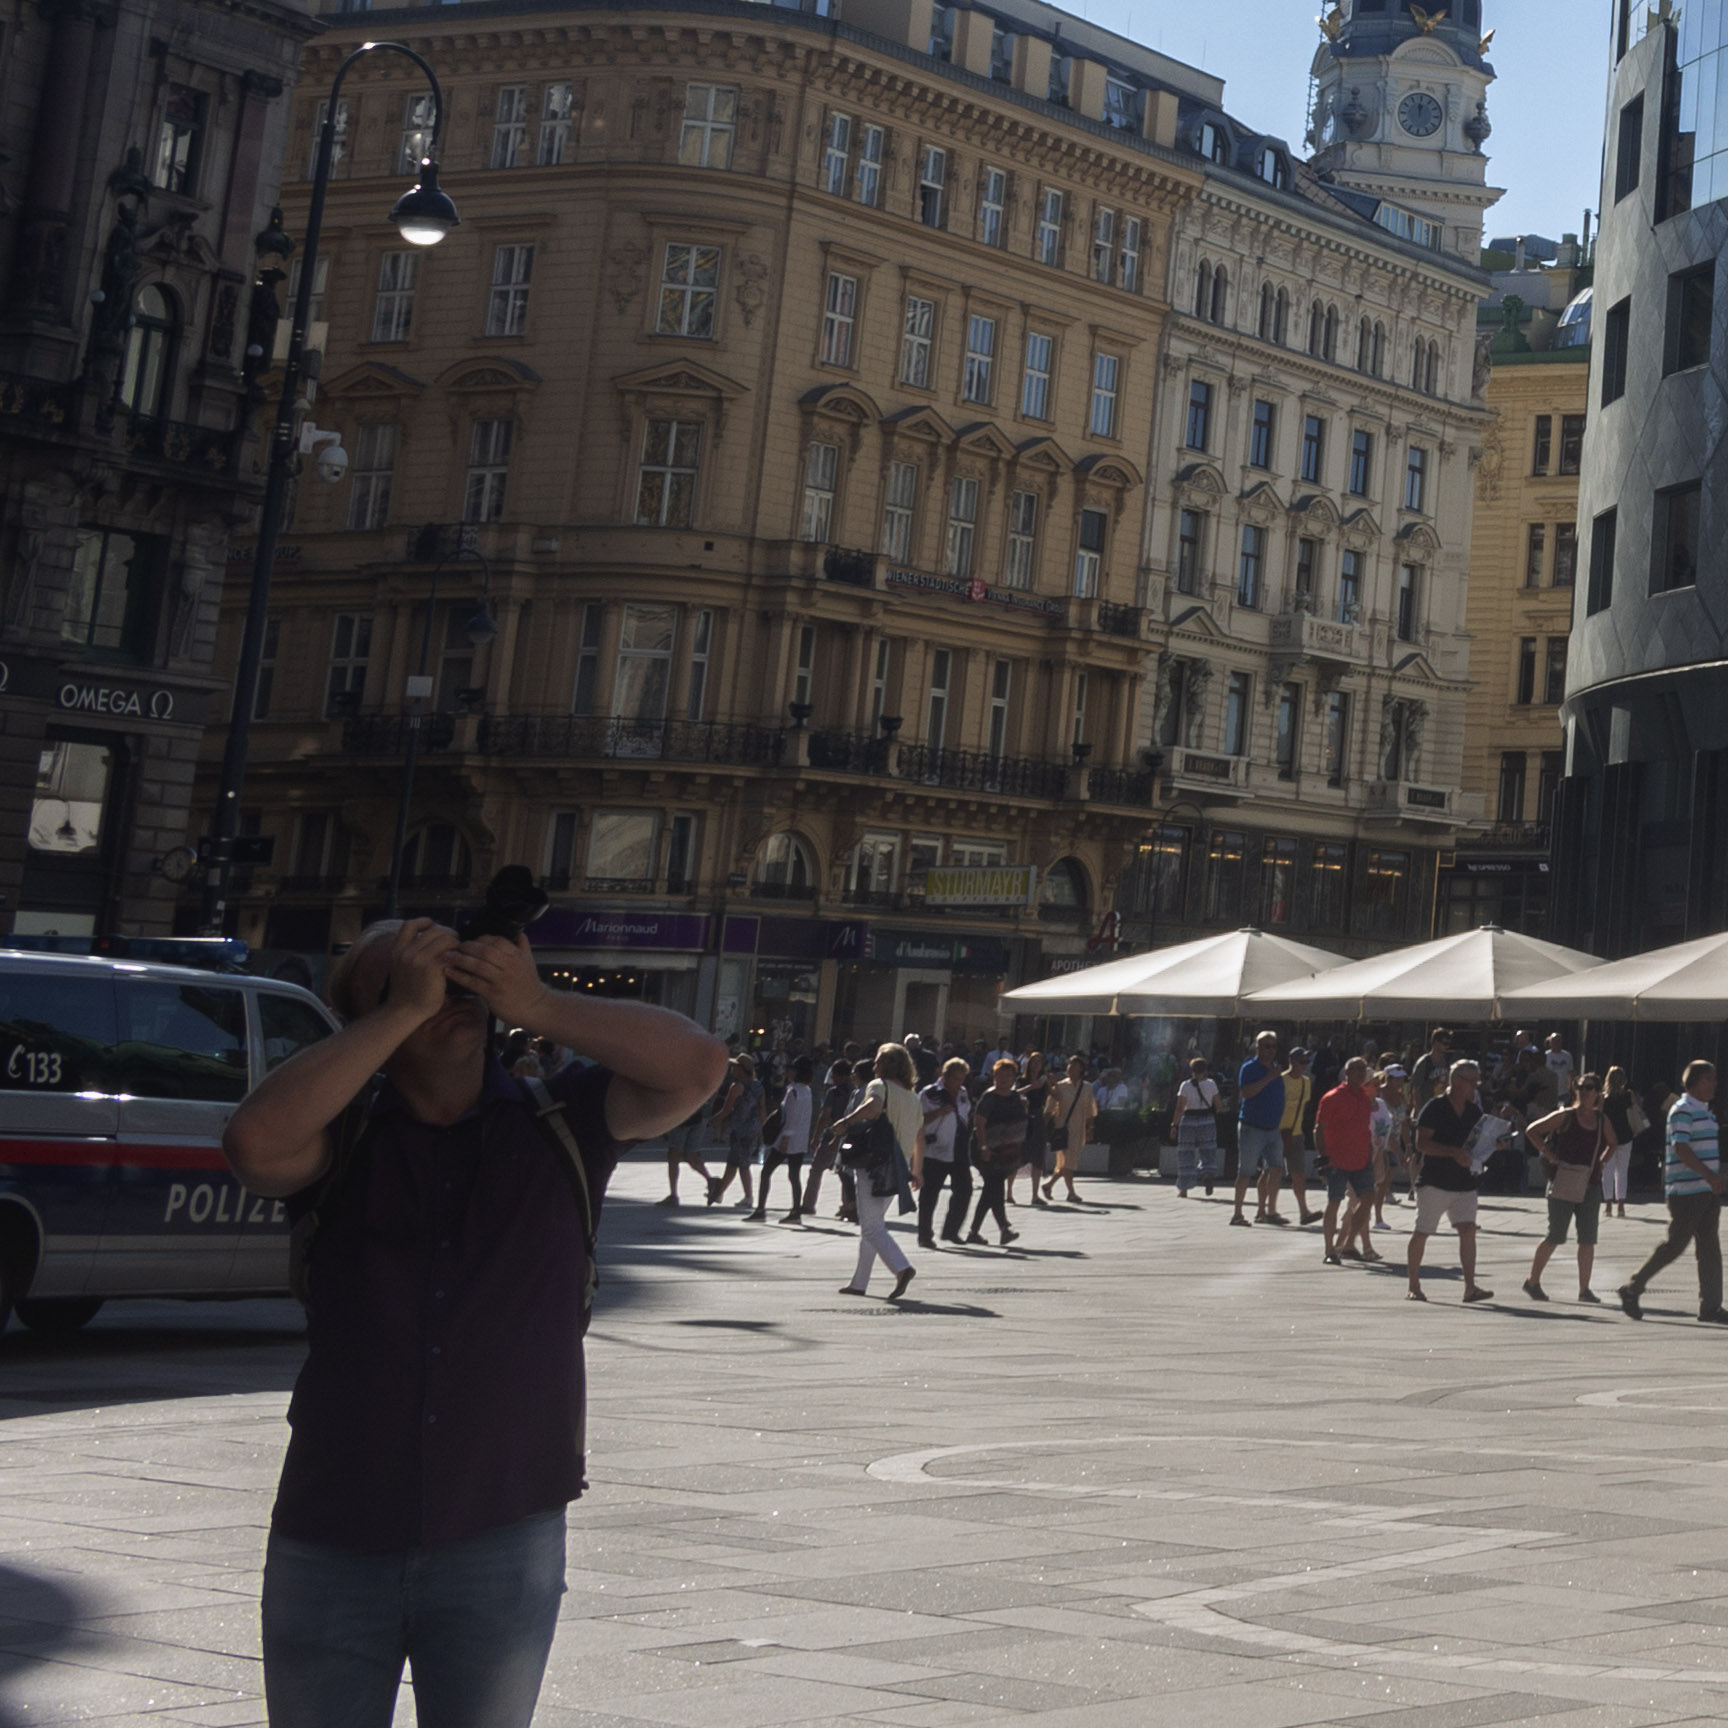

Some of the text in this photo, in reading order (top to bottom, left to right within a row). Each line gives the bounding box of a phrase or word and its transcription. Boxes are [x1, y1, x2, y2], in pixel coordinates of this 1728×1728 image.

[60, 684, 142, 716] OMEGA
[575, 918, 659, 936] Marionnaud
[26, 1052, 62, 1083] 133
[164, 1183, 287, 1223] POLIZE
